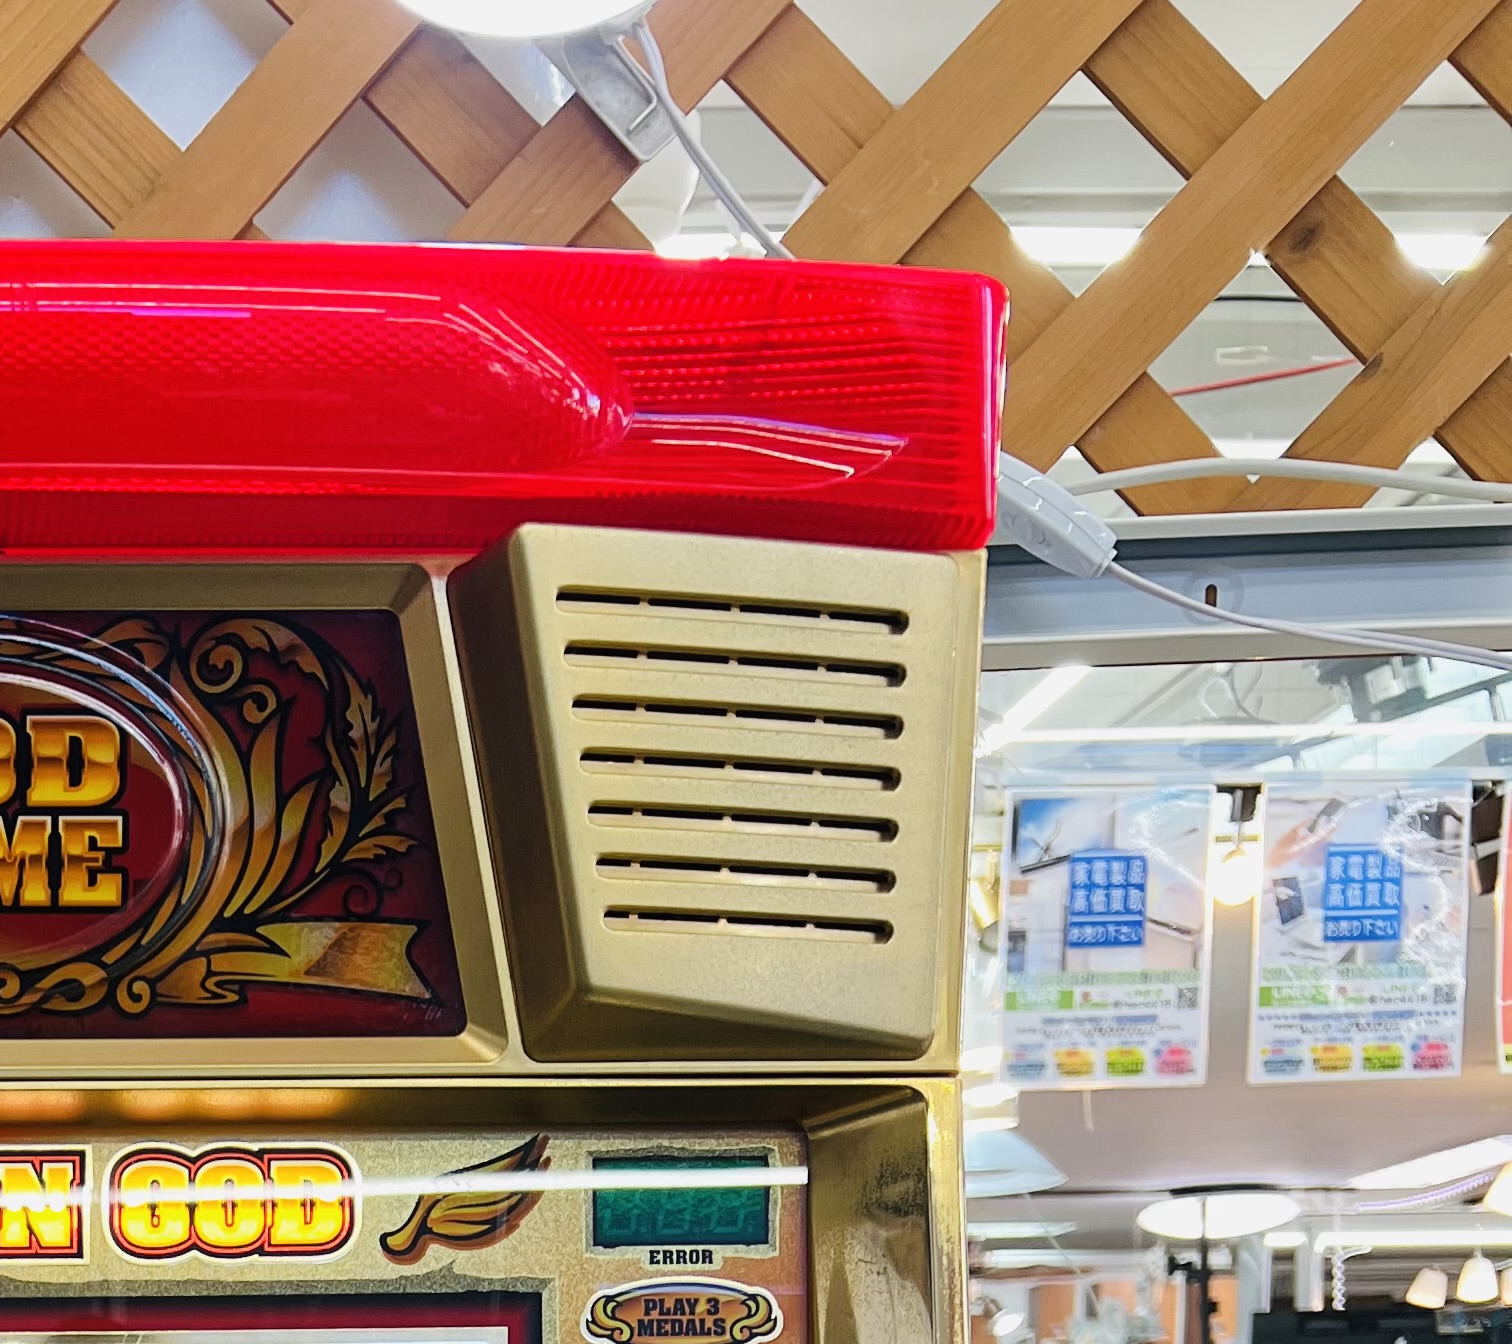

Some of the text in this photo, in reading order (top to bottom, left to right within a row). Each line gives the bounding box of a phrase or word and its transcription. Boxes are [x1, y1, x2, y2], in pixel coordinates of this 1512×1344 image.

[1072, 859, 1144, 886] 家電製品
[1072, 888, 1144, 913] 高価買取
[1329, 883, 1399, 907] 高価買取
[112, 1157, 353, 1258] GOD
[649, 1250, 713, 1265] ERROR
[643, 1298, 721, 1317] PLAY 3
[636, 1318, 727, 1337] MEDALS
